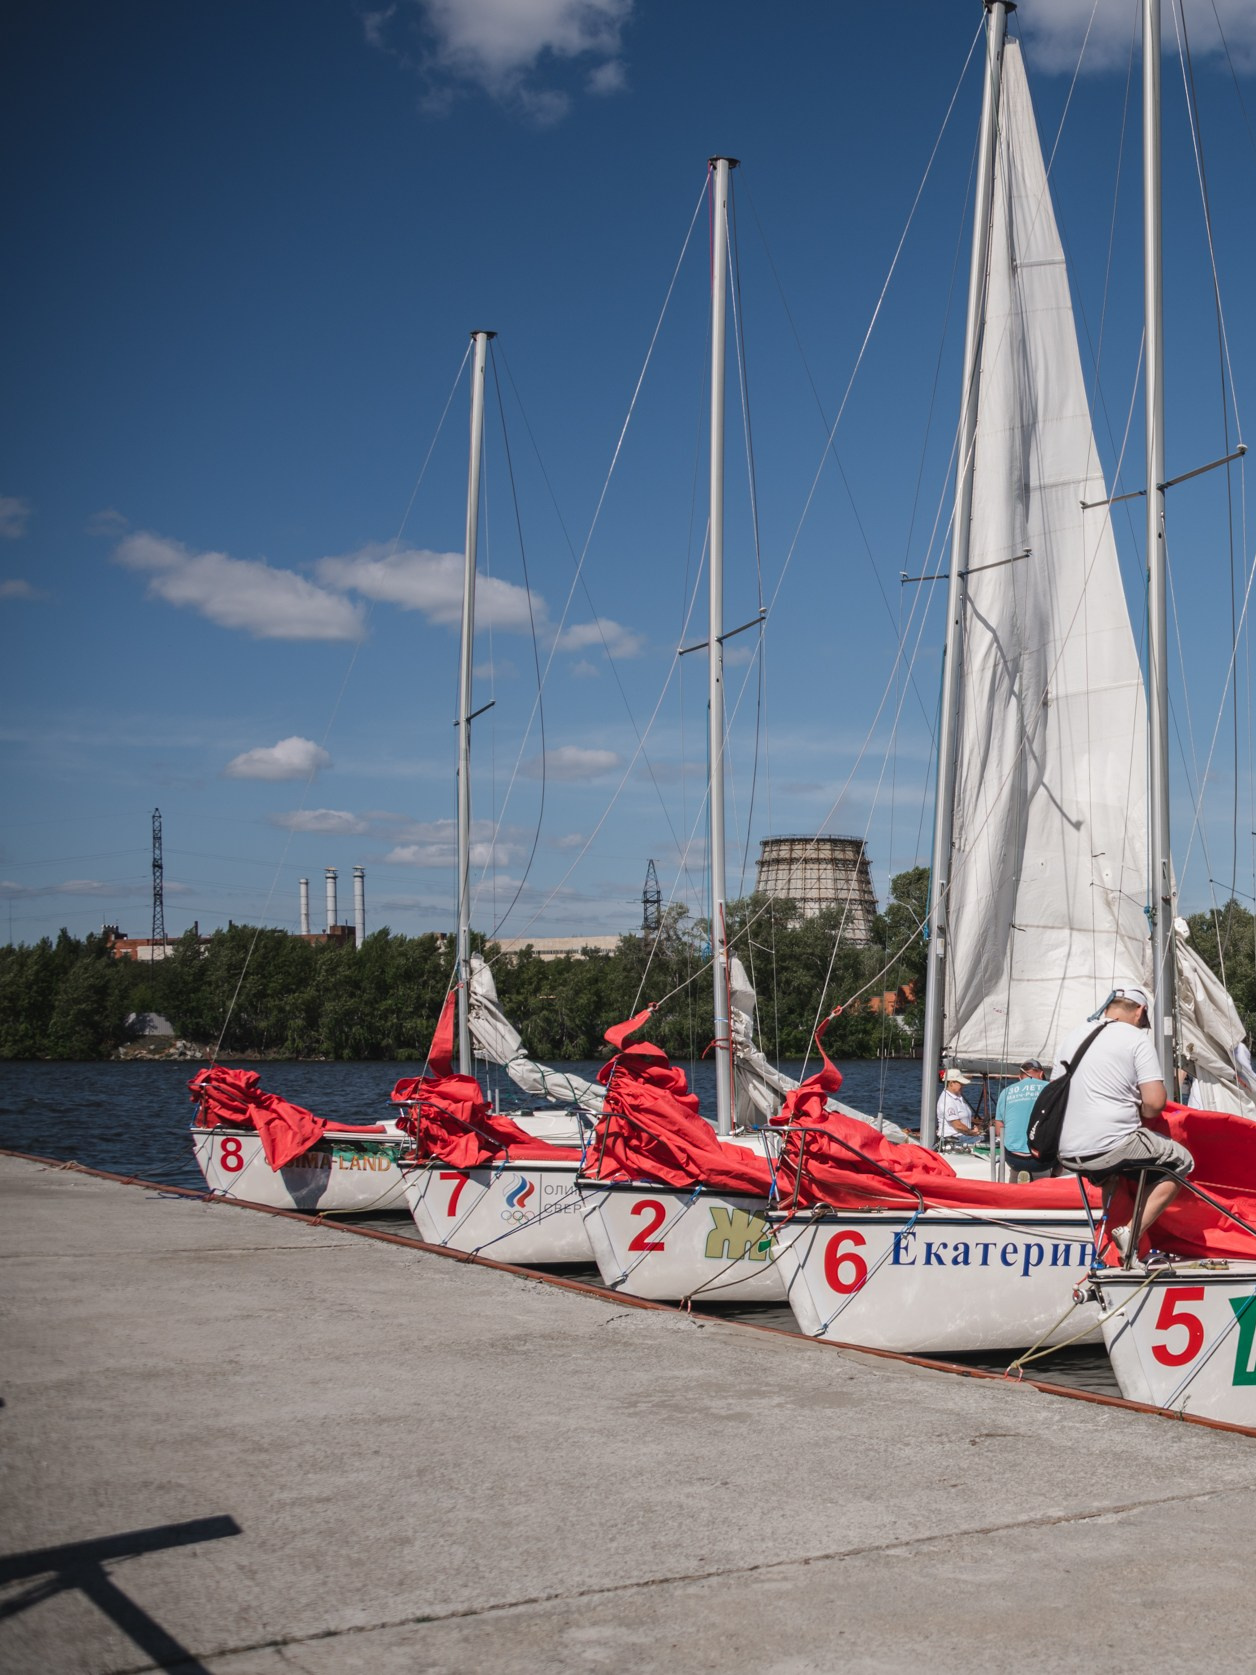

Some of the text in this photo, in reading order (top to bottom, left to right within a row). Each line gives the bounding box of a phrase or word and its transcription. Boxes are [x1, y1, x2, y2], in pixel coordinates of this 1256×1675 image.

[1021, 1084, 1043, 1092] ЛЕТ
[219, 1136, 244, 1173] 8
[438, 1171, 470, 1217] 7
[544, 1184, 578, 1196] ОЛИ
[544, 1203, 582, 1214] СВЕР
[627, 1199, 666, 1252] 2
[705, 1207, 777, 1262] Ж
[824, 1230, 868, 1295] 6
[889, 1230, 1098, 1278] Екатерин
[1151, 1286, 1206, 1368] 5
